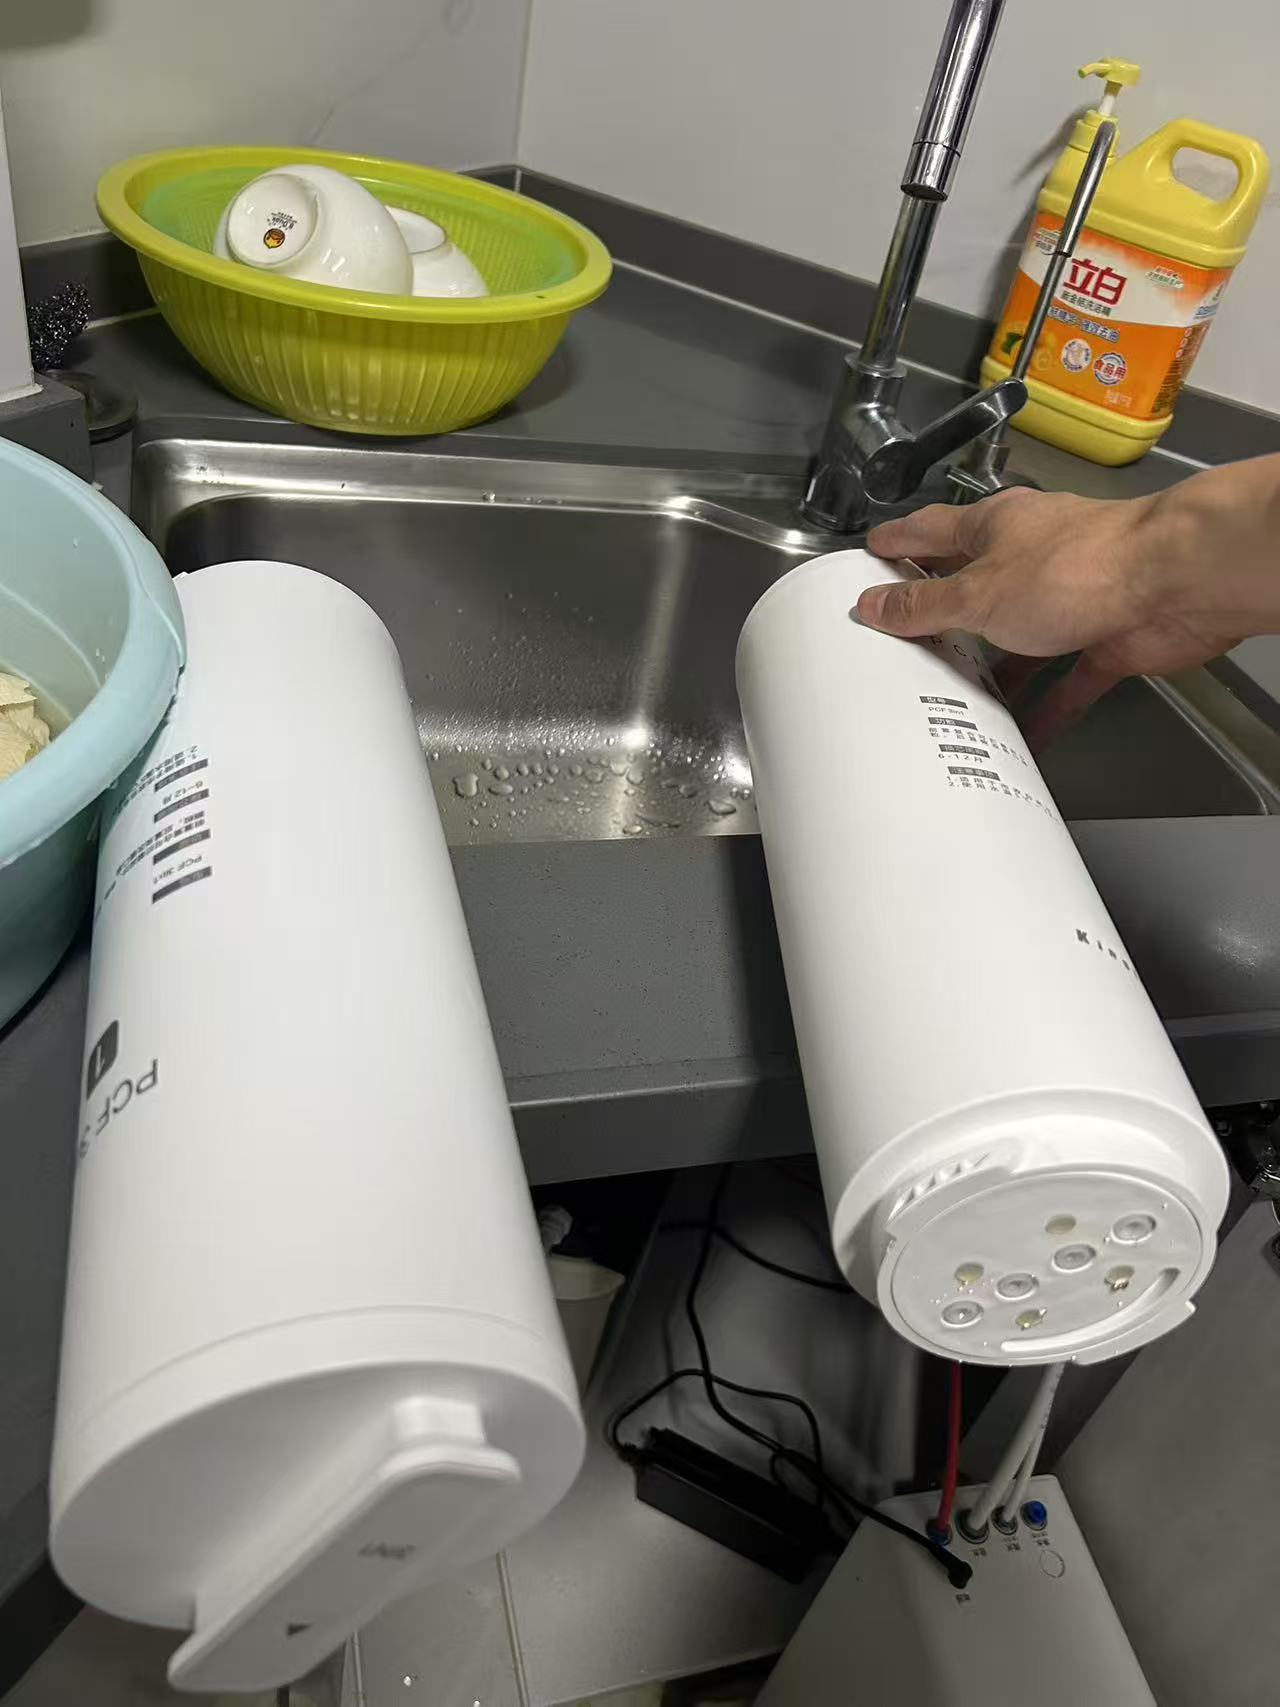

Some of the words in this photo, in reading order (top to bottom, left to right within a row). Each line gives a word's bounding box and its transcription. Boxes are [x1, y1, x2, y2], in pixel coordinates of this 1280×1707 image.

[1063, 258, 1127, 305] 立白
[1093, 356, 1127, 380] 食品用
[96, 1057, 159, 1137] PCF
